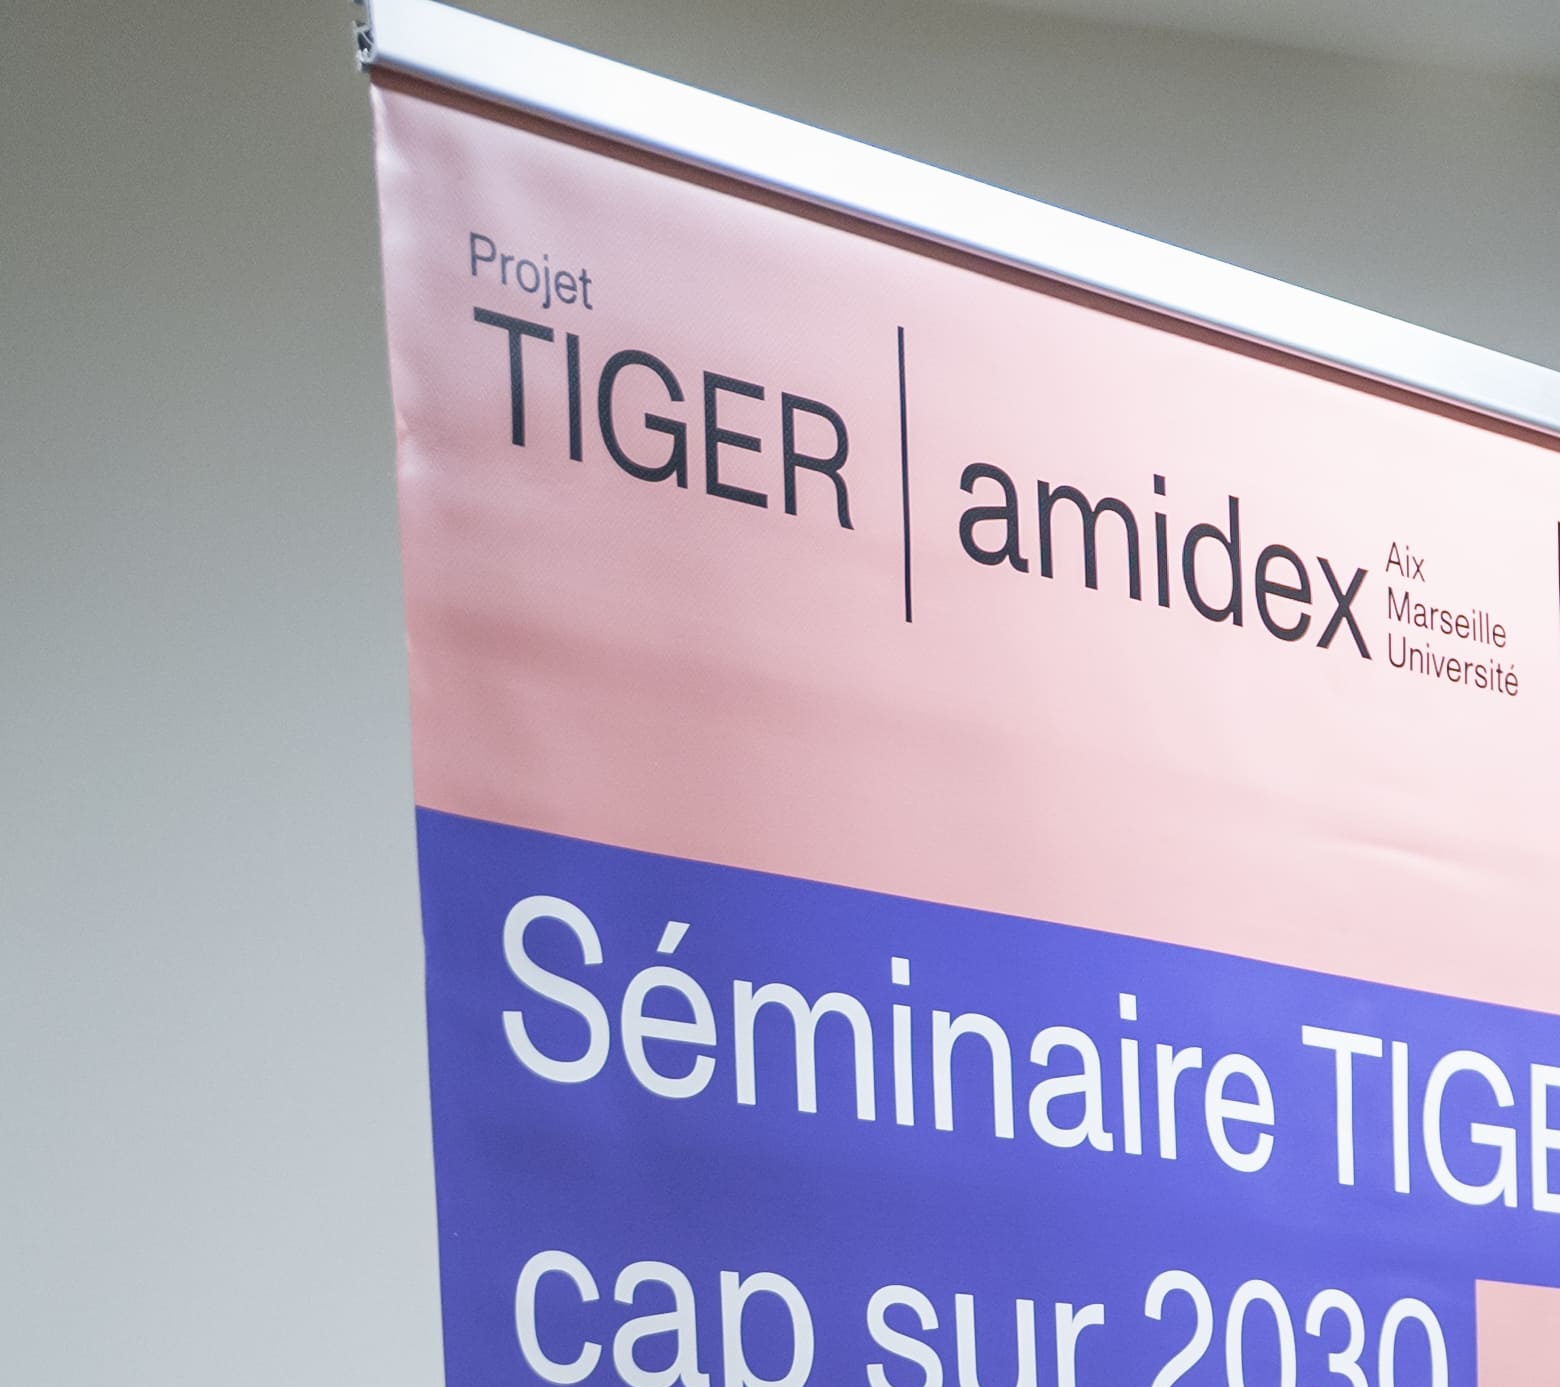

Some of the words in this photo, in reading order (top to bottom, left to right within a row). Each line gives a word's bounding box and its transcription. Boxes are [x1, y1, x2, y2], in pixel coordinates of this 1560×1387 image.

[468, 231, 594, 312] Projet
[473, 306, 854, 531] TIGER
[958, 462, 1373, 660] amidex
[1385, 541, 1426, 583] Aix
[1387, 586, 1508, 649] Marseille
[1388, 632, 1520, 698] Université
[502, 895, 1275, 1174] Séminaire
